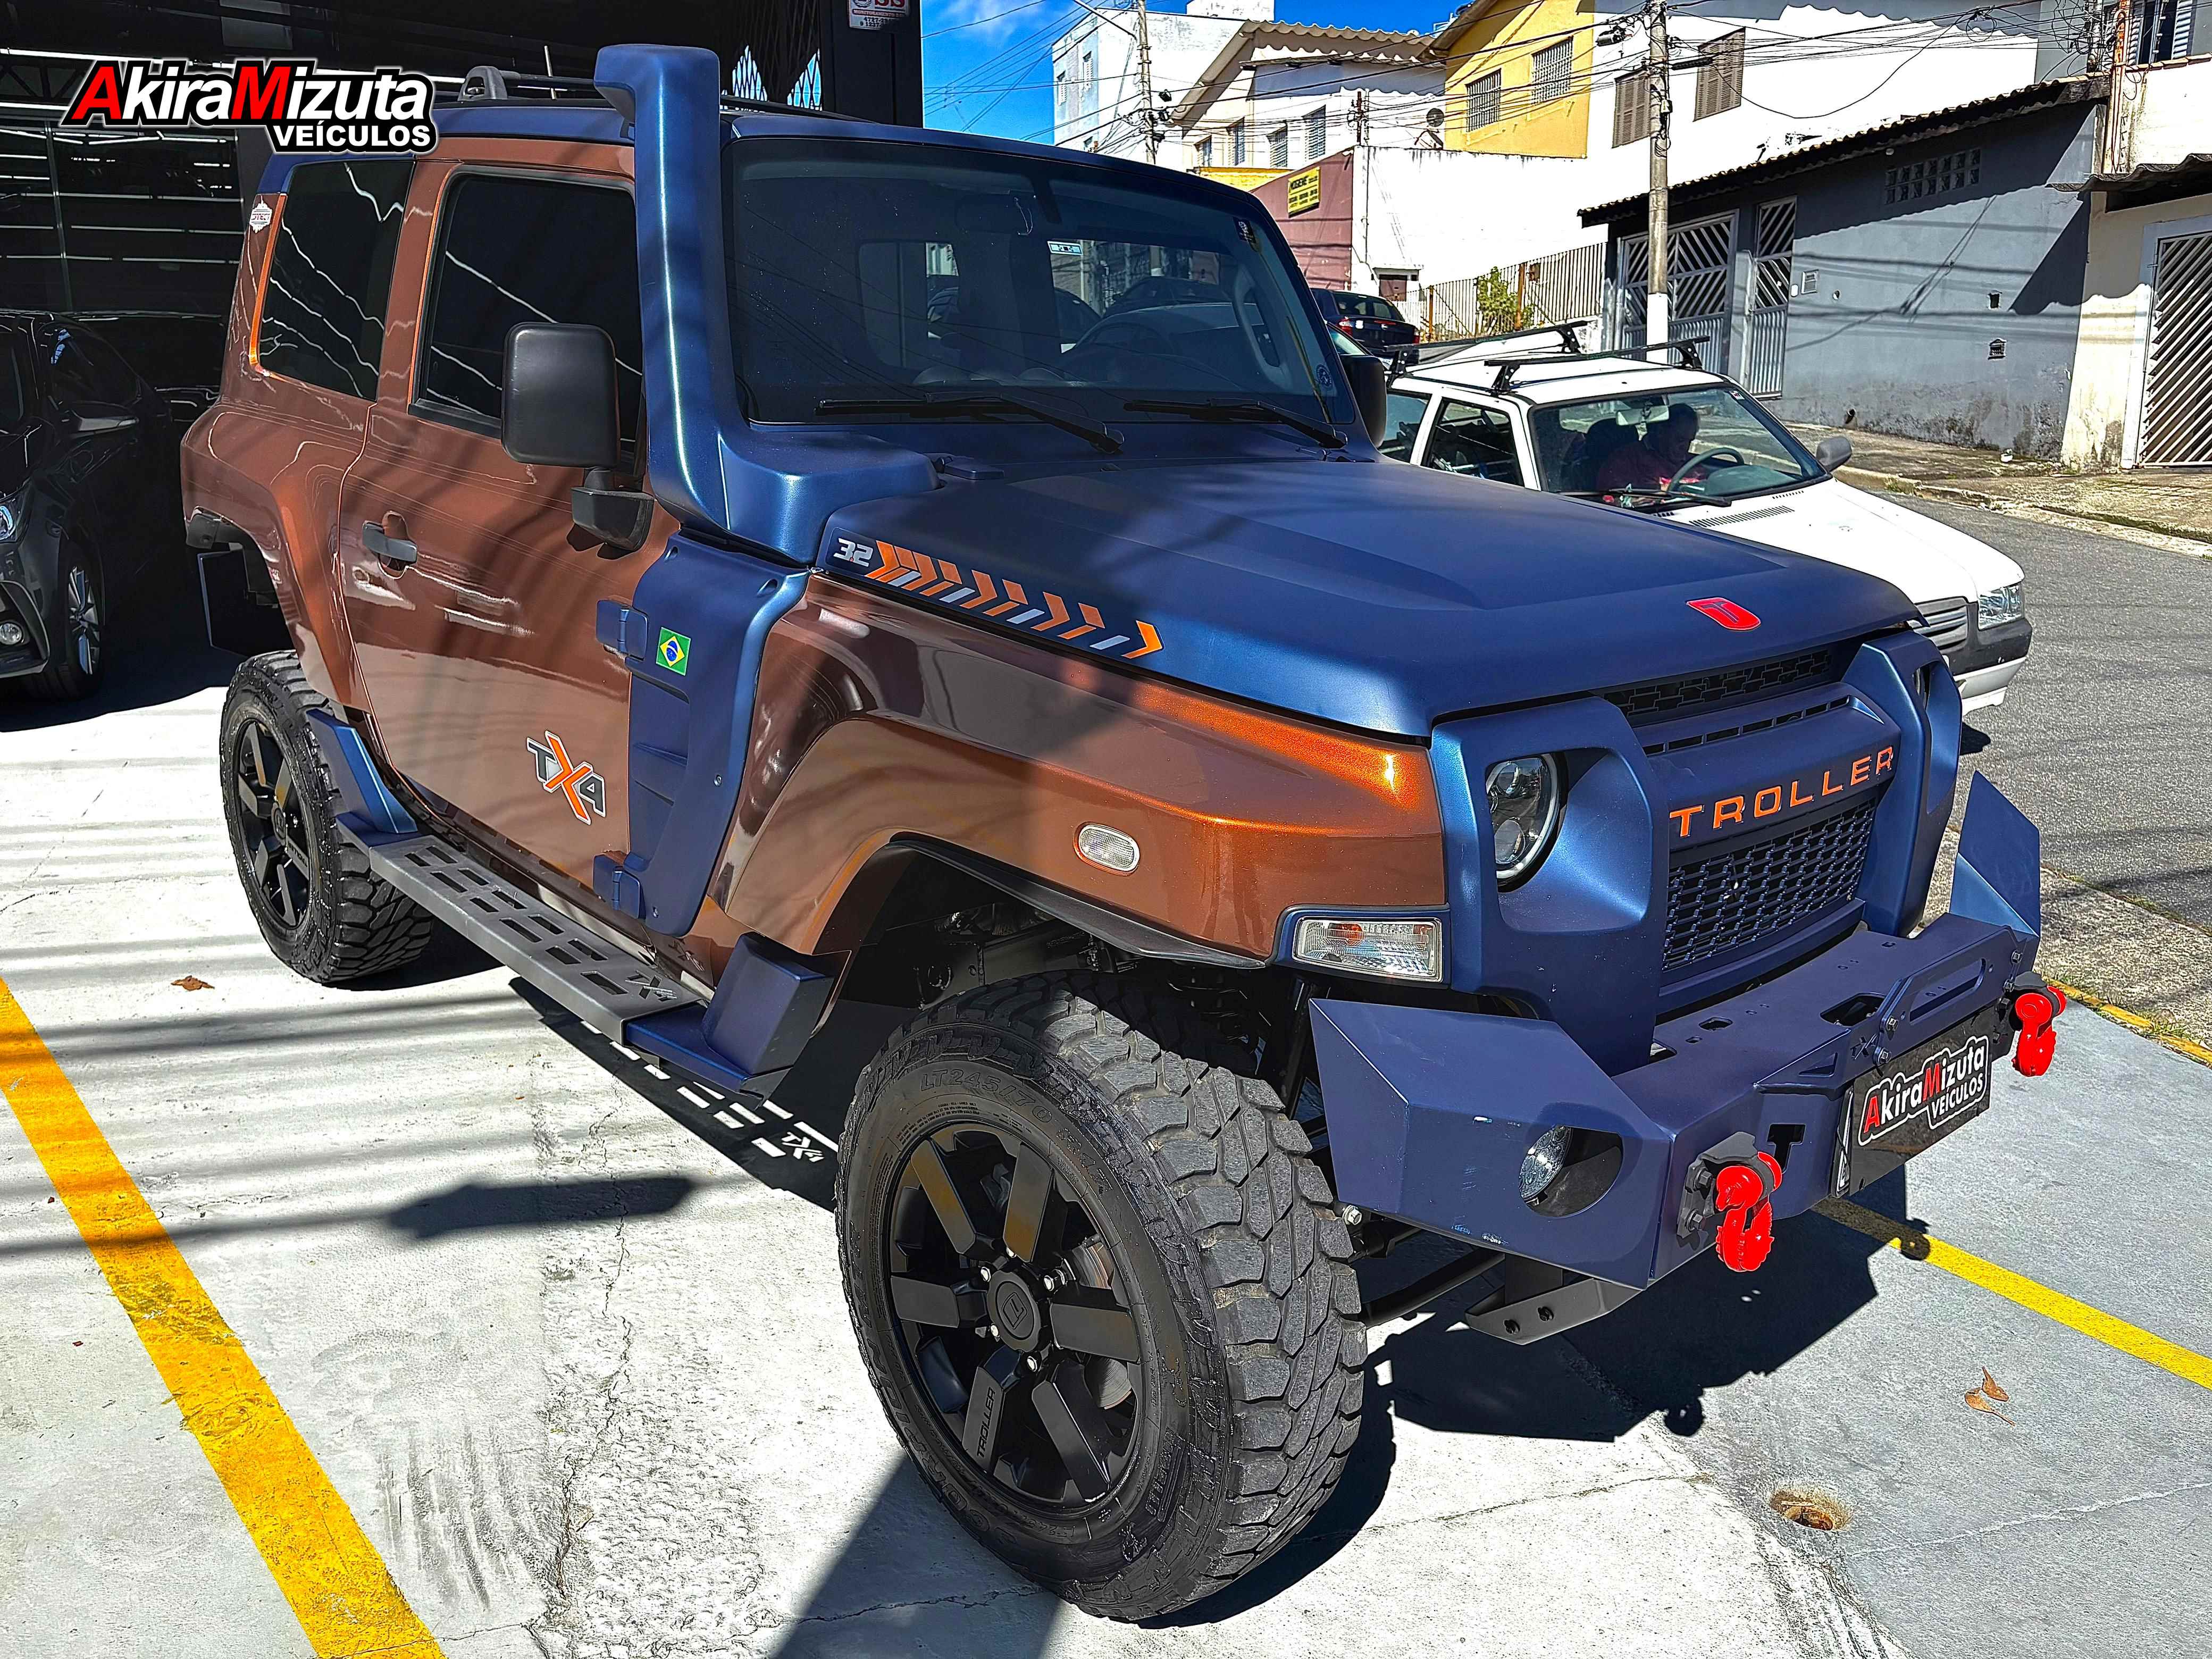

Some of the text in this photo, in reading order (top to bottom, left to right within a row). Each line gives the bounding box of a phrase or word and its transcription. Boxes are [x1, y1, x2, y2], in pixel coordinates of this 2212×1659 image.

[1669, 745, 1894, 837] TROLLER
[1931, 1073, 1984, 1119] VEÍCULOS
[976, 1386, 996, 1458] TROLLER
